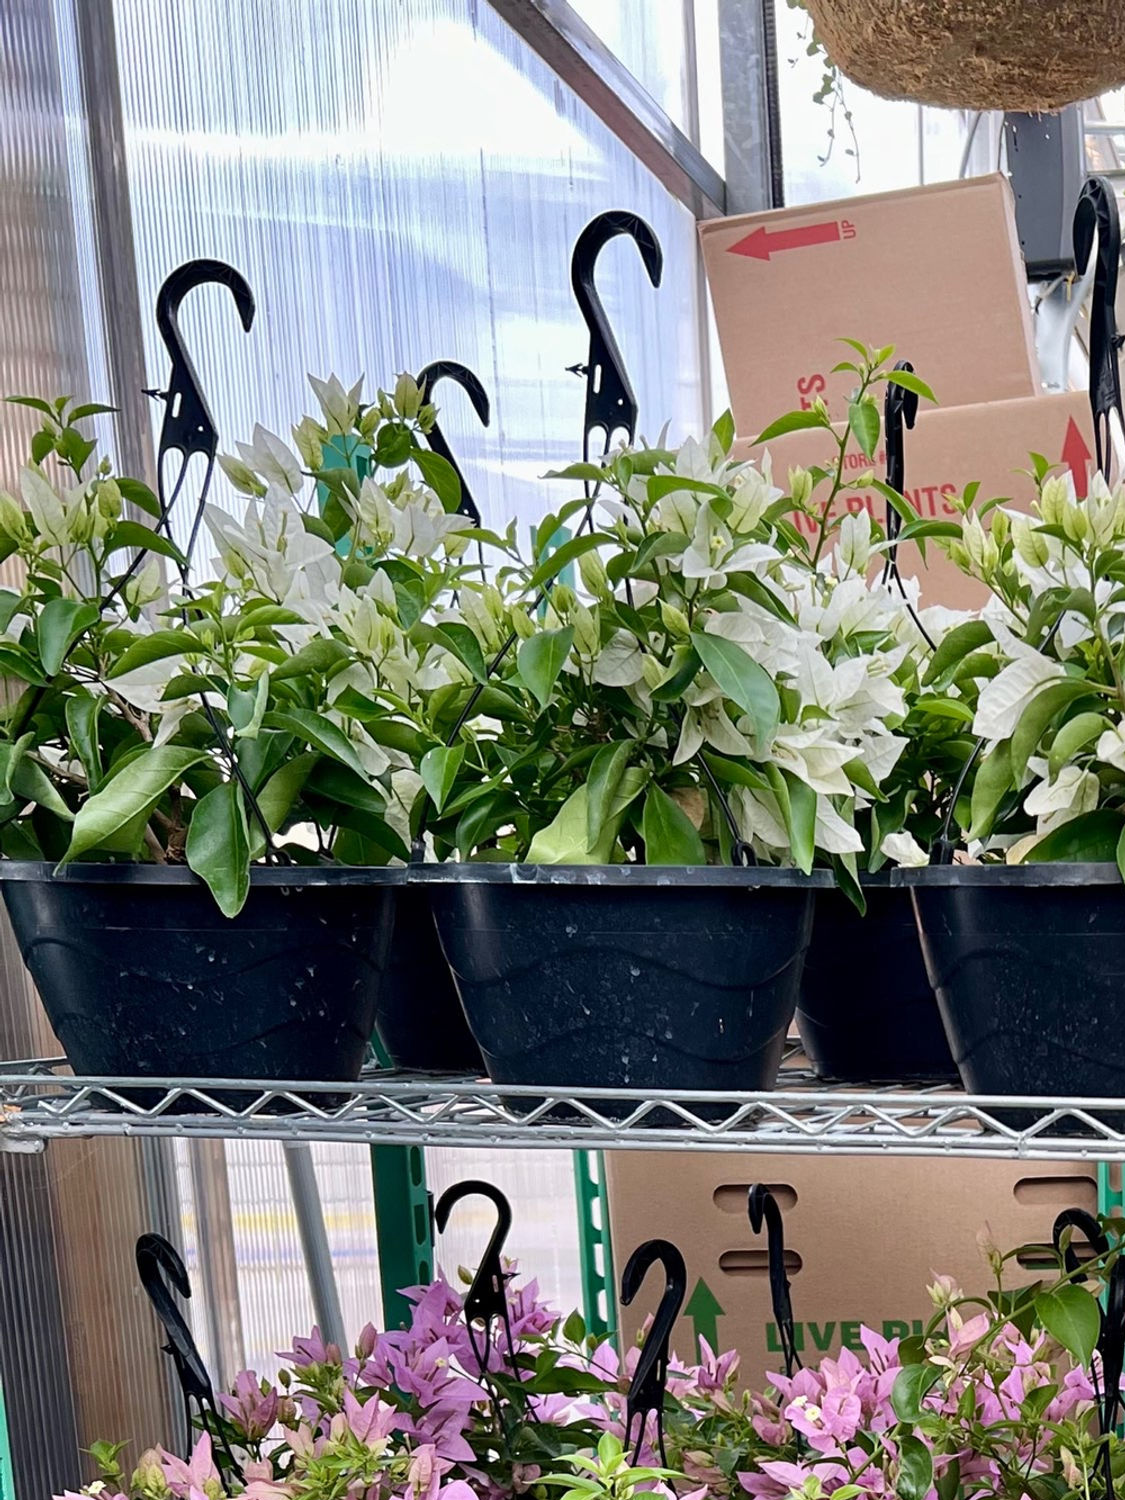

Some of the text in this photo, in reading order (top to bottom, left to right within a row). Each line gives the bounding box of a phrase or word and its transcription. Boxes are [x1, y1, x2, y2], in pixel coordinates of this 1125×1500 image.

[842, 219, 857, 240] UP
[846, 482, 958, 525] PLNTS
[765, 1319, 869, 1353] LIVE
